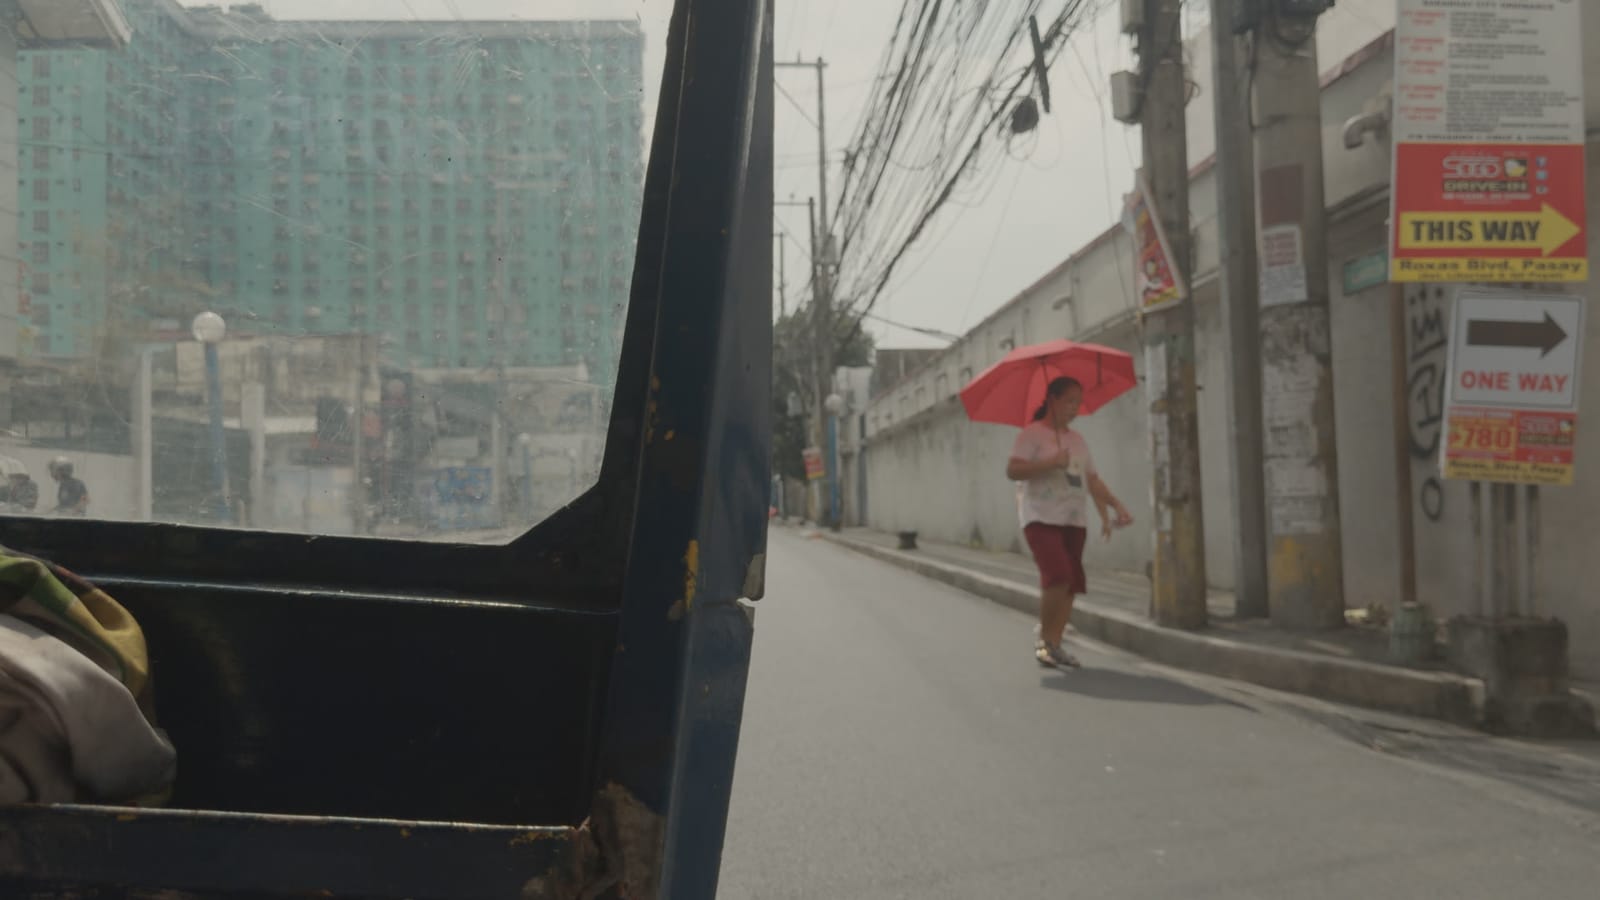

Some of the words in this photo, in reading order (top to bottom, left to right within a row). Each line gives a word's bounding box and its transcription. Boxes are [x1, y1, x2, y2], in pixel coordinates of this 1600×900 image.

[1411, 220, 1473, 241] THIS
[1481, 220, 1541, 242] WAY
[1400, 259, 1459, 271] Roxas
[1522, 260, 1582, 273] Pasay
[1460, 370, 1510, 391] ONE
[1519, 373, 1568, 393] WAY
